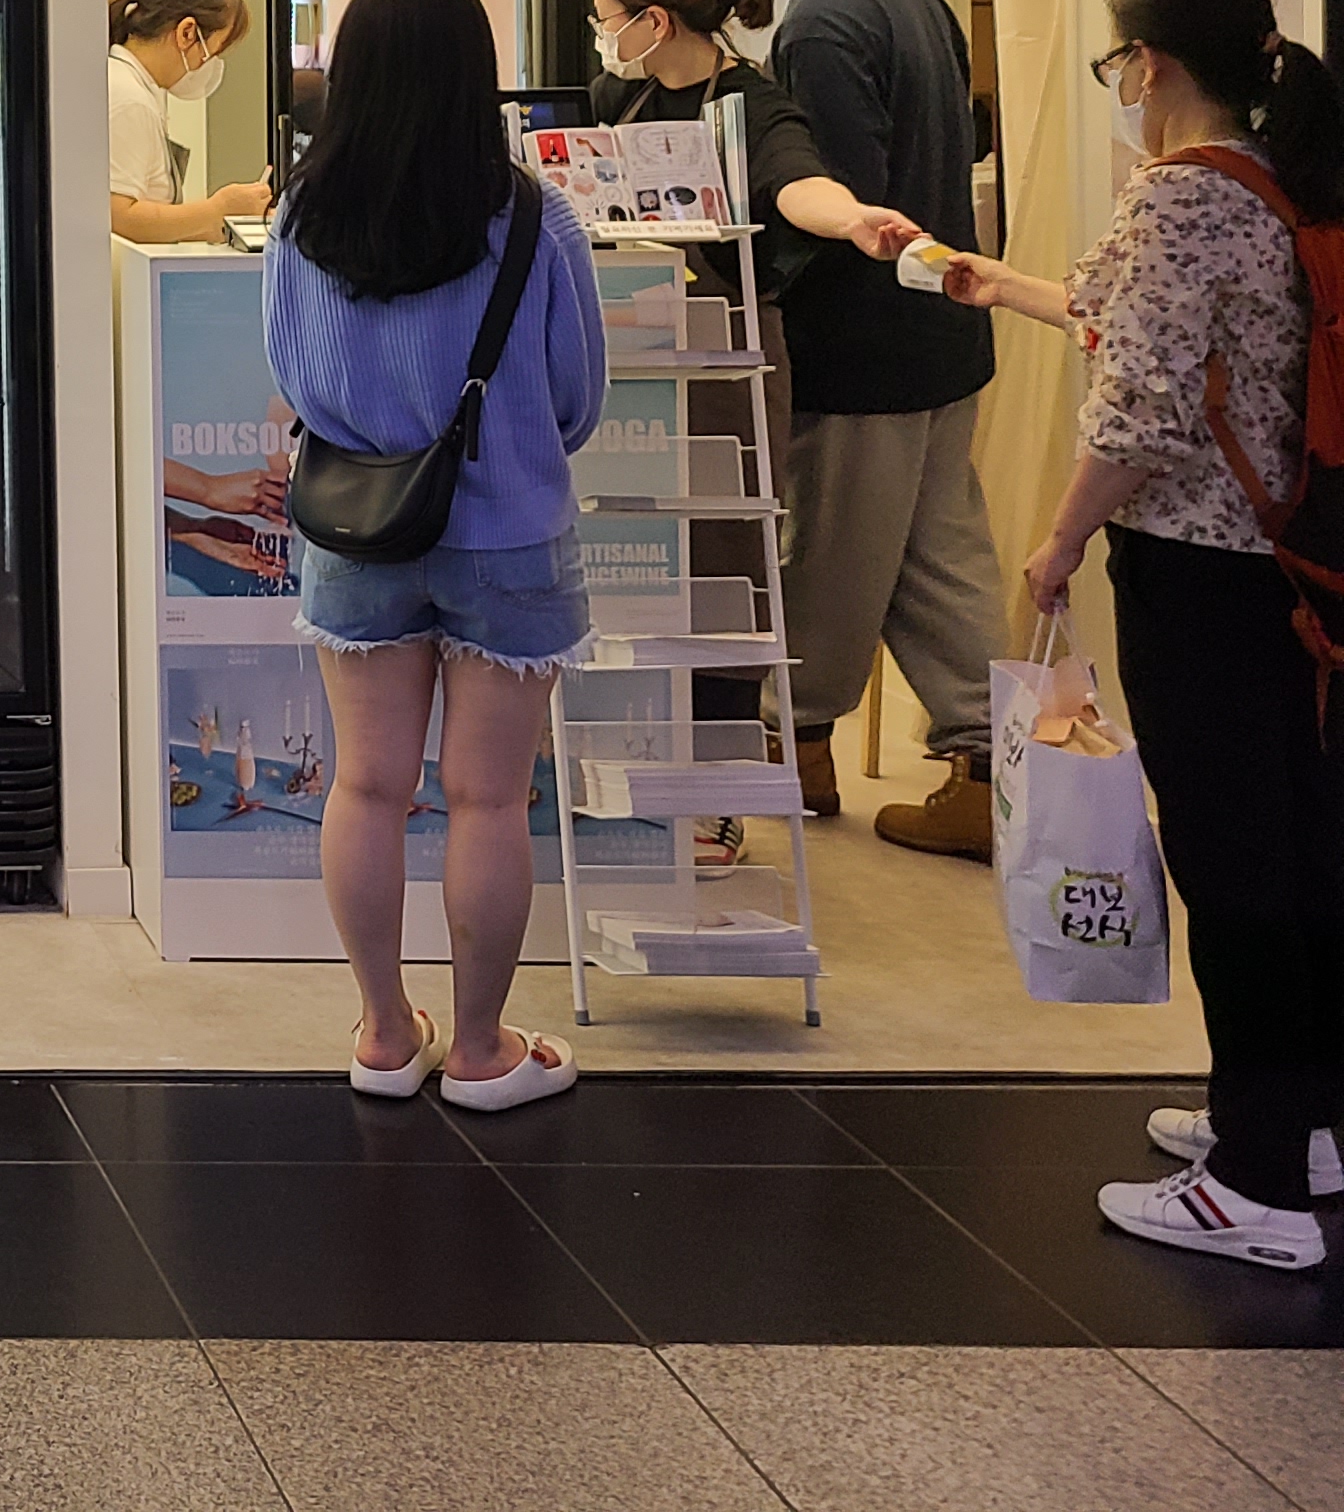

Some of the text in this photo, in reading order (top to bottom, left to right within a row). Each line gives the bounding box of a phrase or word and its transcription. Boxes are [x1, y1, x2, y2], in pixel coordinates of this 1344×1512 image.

[172, 421, 299, 456] BOKSOO
[591, 419, 670, 452] OGA
[580, 543, 670, 563] RTISANAL
